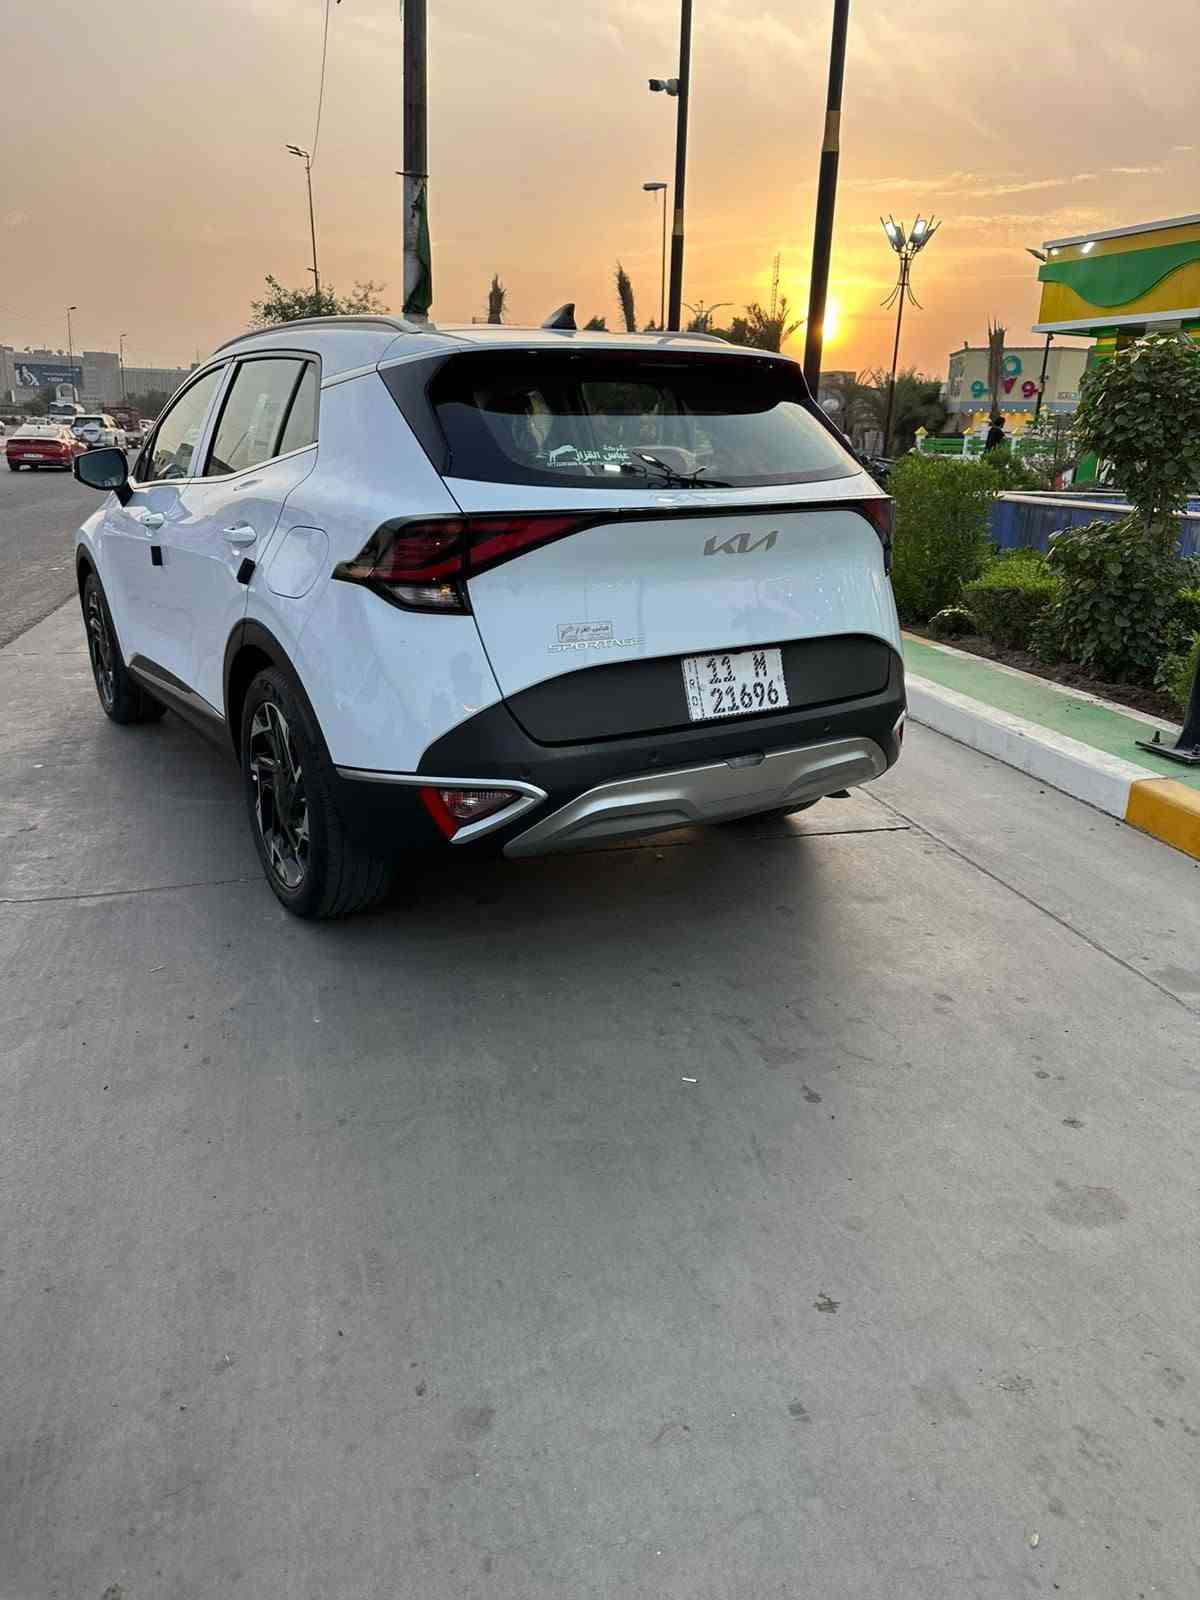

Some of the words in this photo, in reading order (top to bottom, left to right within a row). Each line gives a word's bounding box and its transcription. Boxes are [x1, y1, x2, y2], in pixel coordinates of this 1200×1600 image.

[703, 530, 779, 555] KIA
[706, 656, 737, 684] 11
[710, 679, 780, 714] 21696
